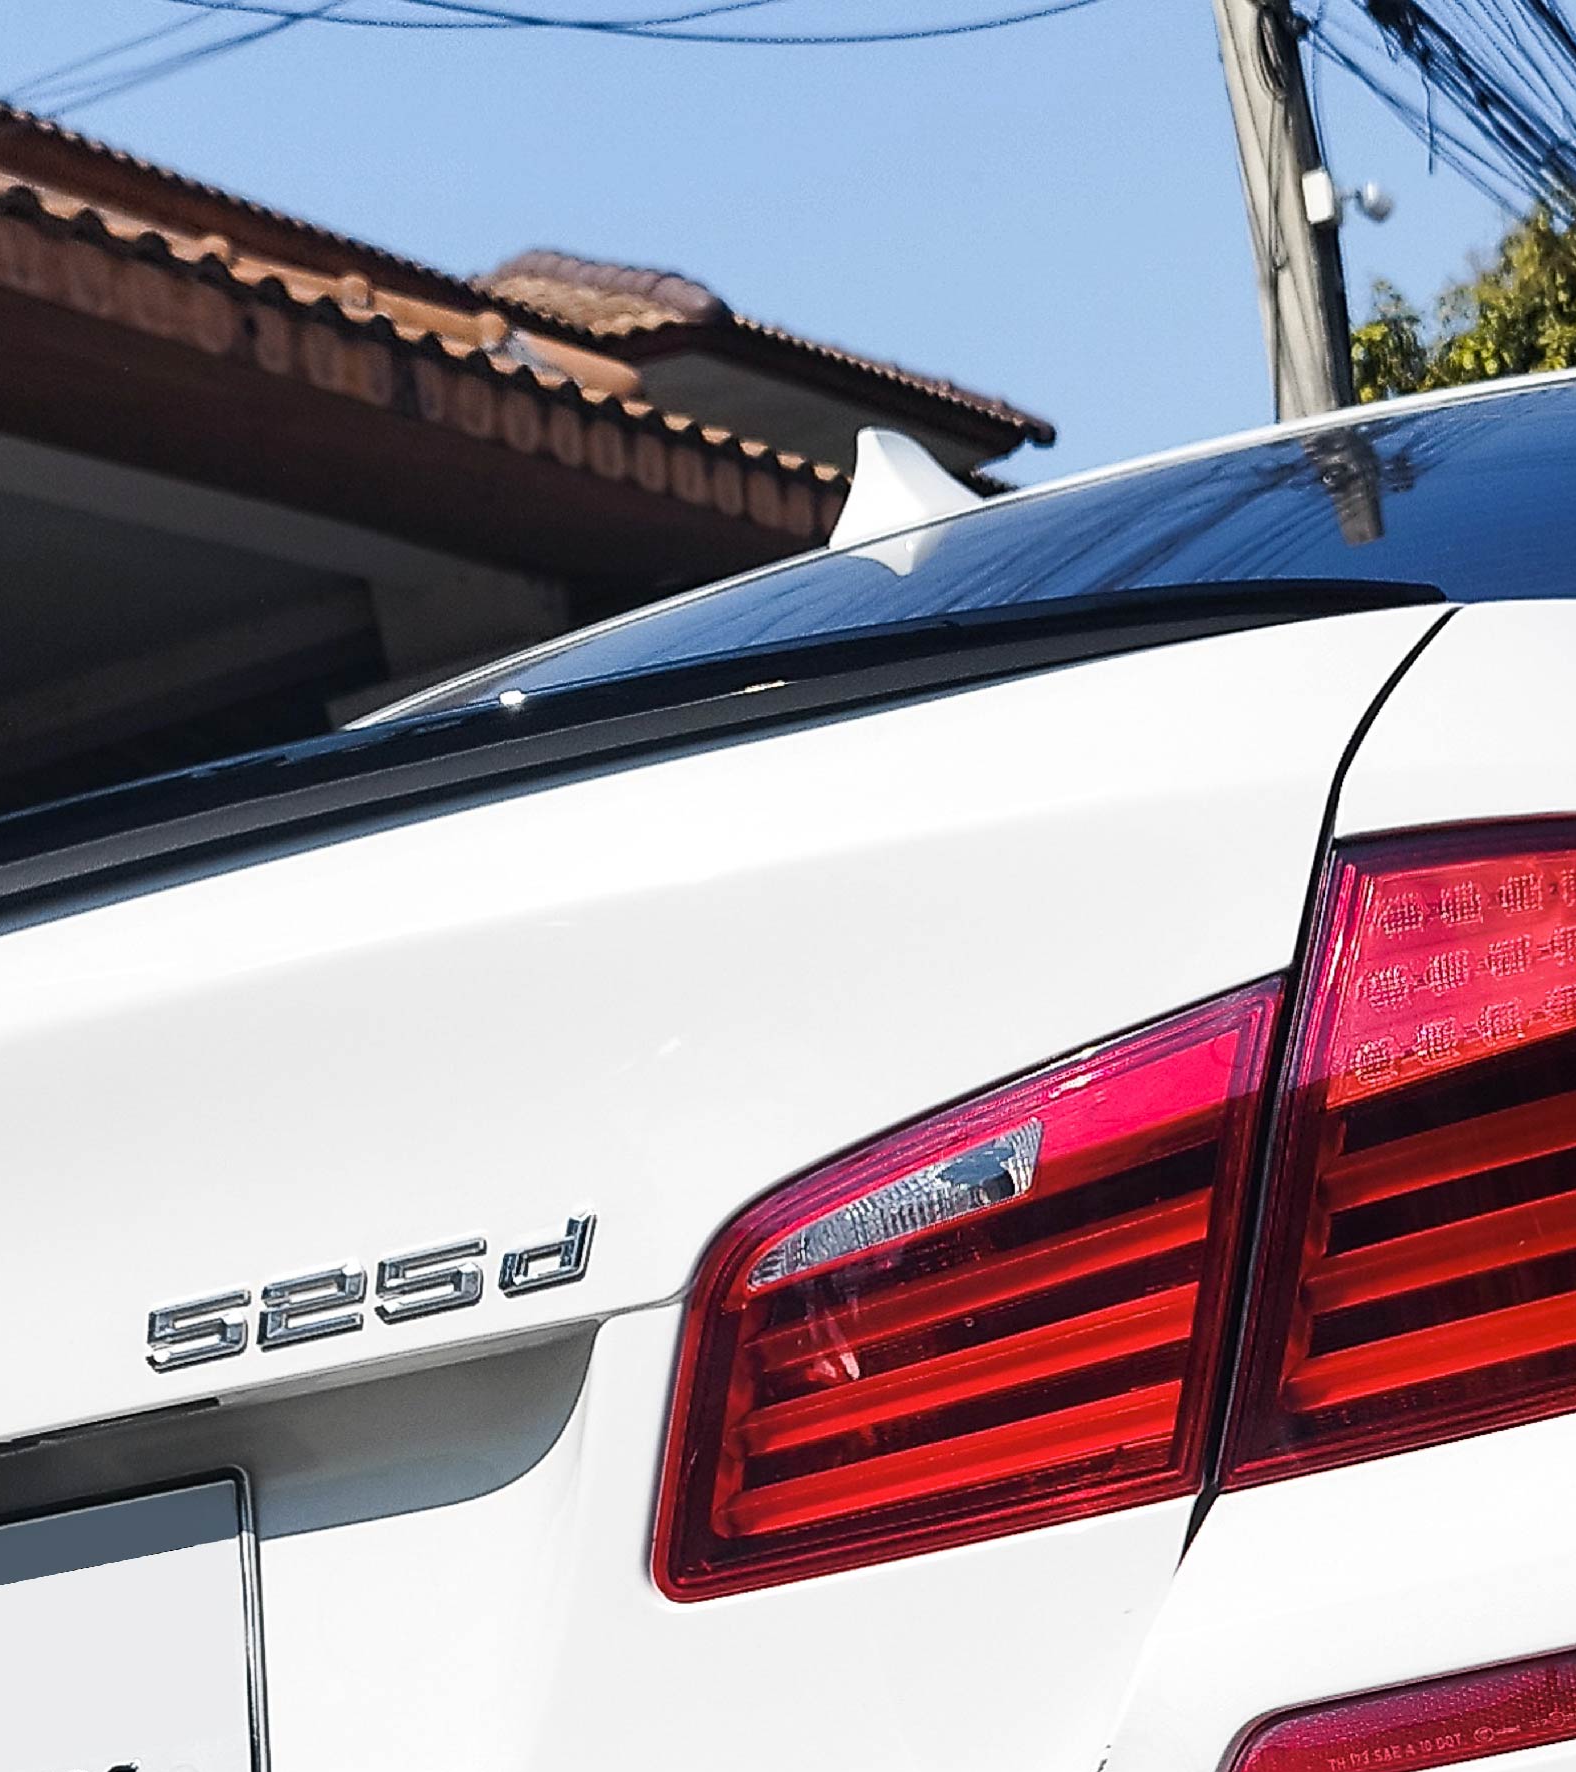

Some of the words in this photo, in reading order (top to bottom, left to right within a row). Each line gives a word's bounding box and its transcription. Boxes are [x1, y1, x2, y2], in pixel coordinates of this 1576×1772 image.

[145, 1209, 596, 1373] 525d
[1374, 1745, 1403, 1763] SAE
[1436, 1733, 1462, 1751] DOT
